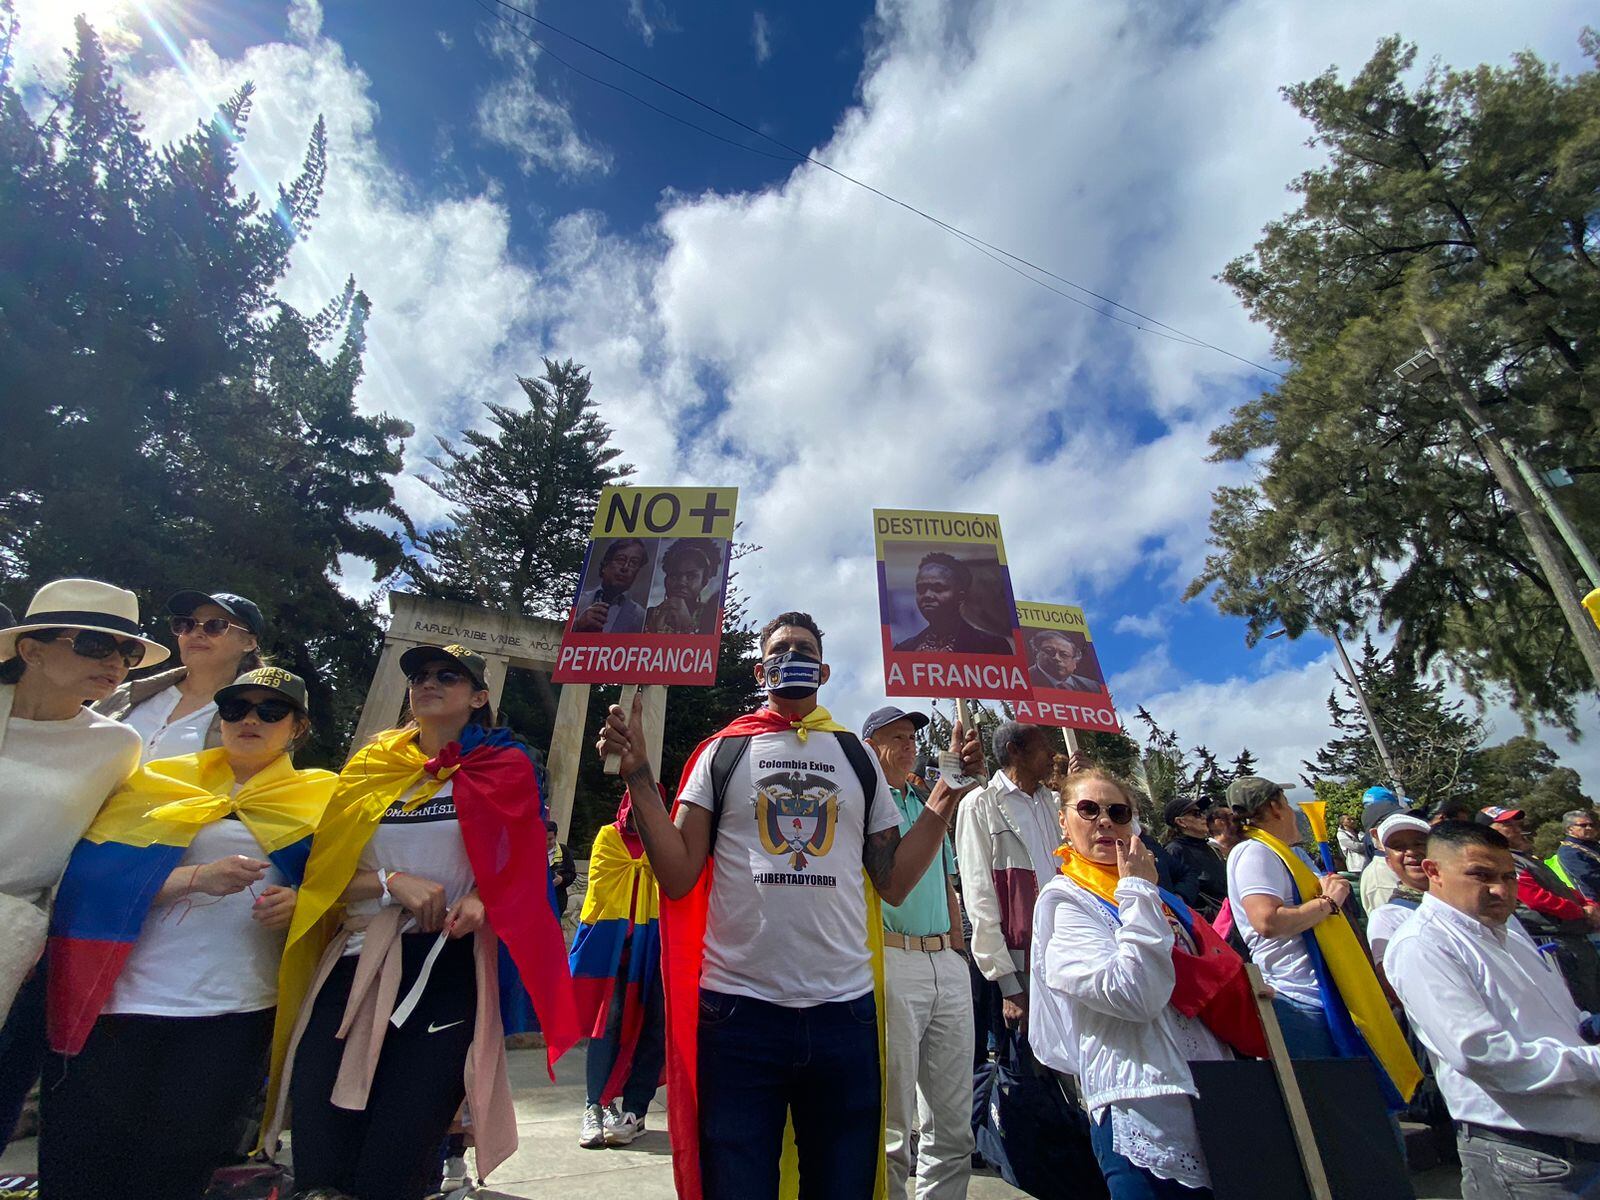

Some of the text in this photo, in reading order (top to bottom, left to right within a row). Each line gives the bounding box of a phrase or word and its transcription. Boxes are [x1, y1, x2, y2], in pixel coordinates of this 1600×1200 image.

[604, 492, 681, 534] NO
[878, 516, 998, 539] DESTITUCIÓN
[414, 621, 455, 636] RAFAEL
[559, 646, 714, 674] PETROFRANCIA
[249, 666, 292, 682] CURSO
[888, 662, 1028, 691] A FRANCIA
[1017, 701, 1114, 726] A PETRO
[759, 759, 835, 773] Colombia Exige
[753, 872, 837, 887] #LIBERTADYORDEN
